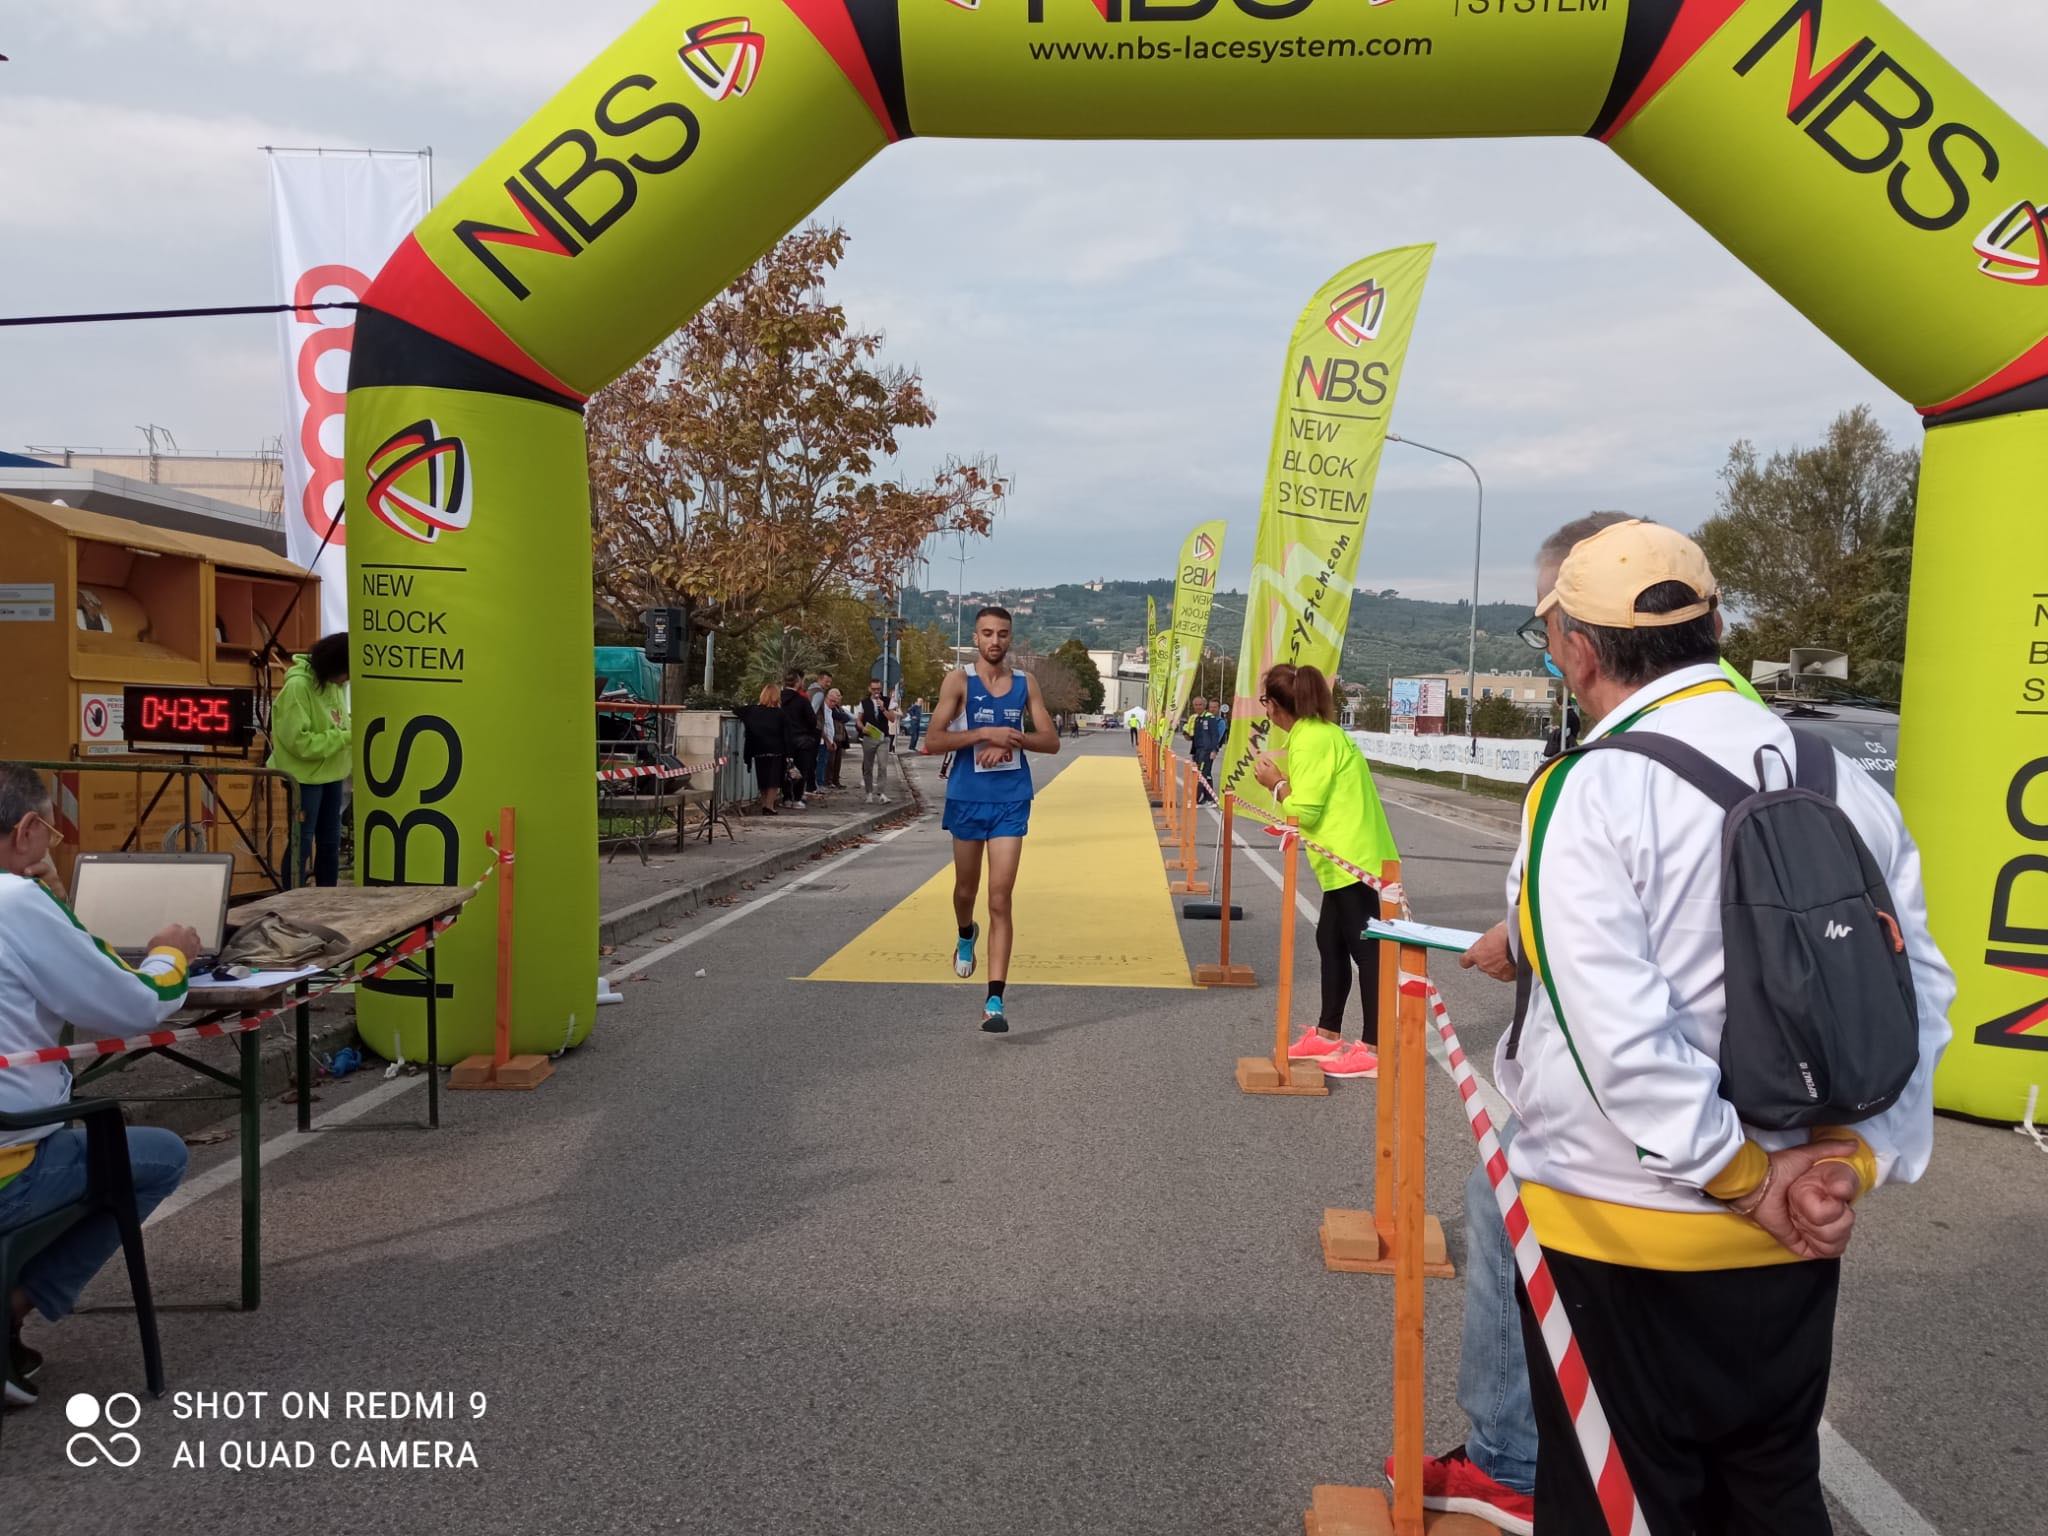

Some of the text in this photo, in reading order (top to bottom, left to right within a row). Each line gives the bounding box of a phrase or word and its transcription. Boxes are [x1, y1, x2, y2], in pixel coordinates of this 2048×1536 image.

[1029, 34, 1433, 64] www.nbs-lacesystem.com
[1733, 0, 2000, 231] NBS
[453, 74, 700, 301] NBS
[1296, 355, 1389, 405] NBS
[1290, 417, 1341, 443] NEW
[1283, 449, 1358, 479] BLOCK
[1279, 481, 1367, 513] SYSTEM
[363, 573, 414, 598] NEW
[363, 608, 447, 635] BLOCK
[362, 643, 464, 671] SYSTEM
[1865, 741, 1887, 754] C5
